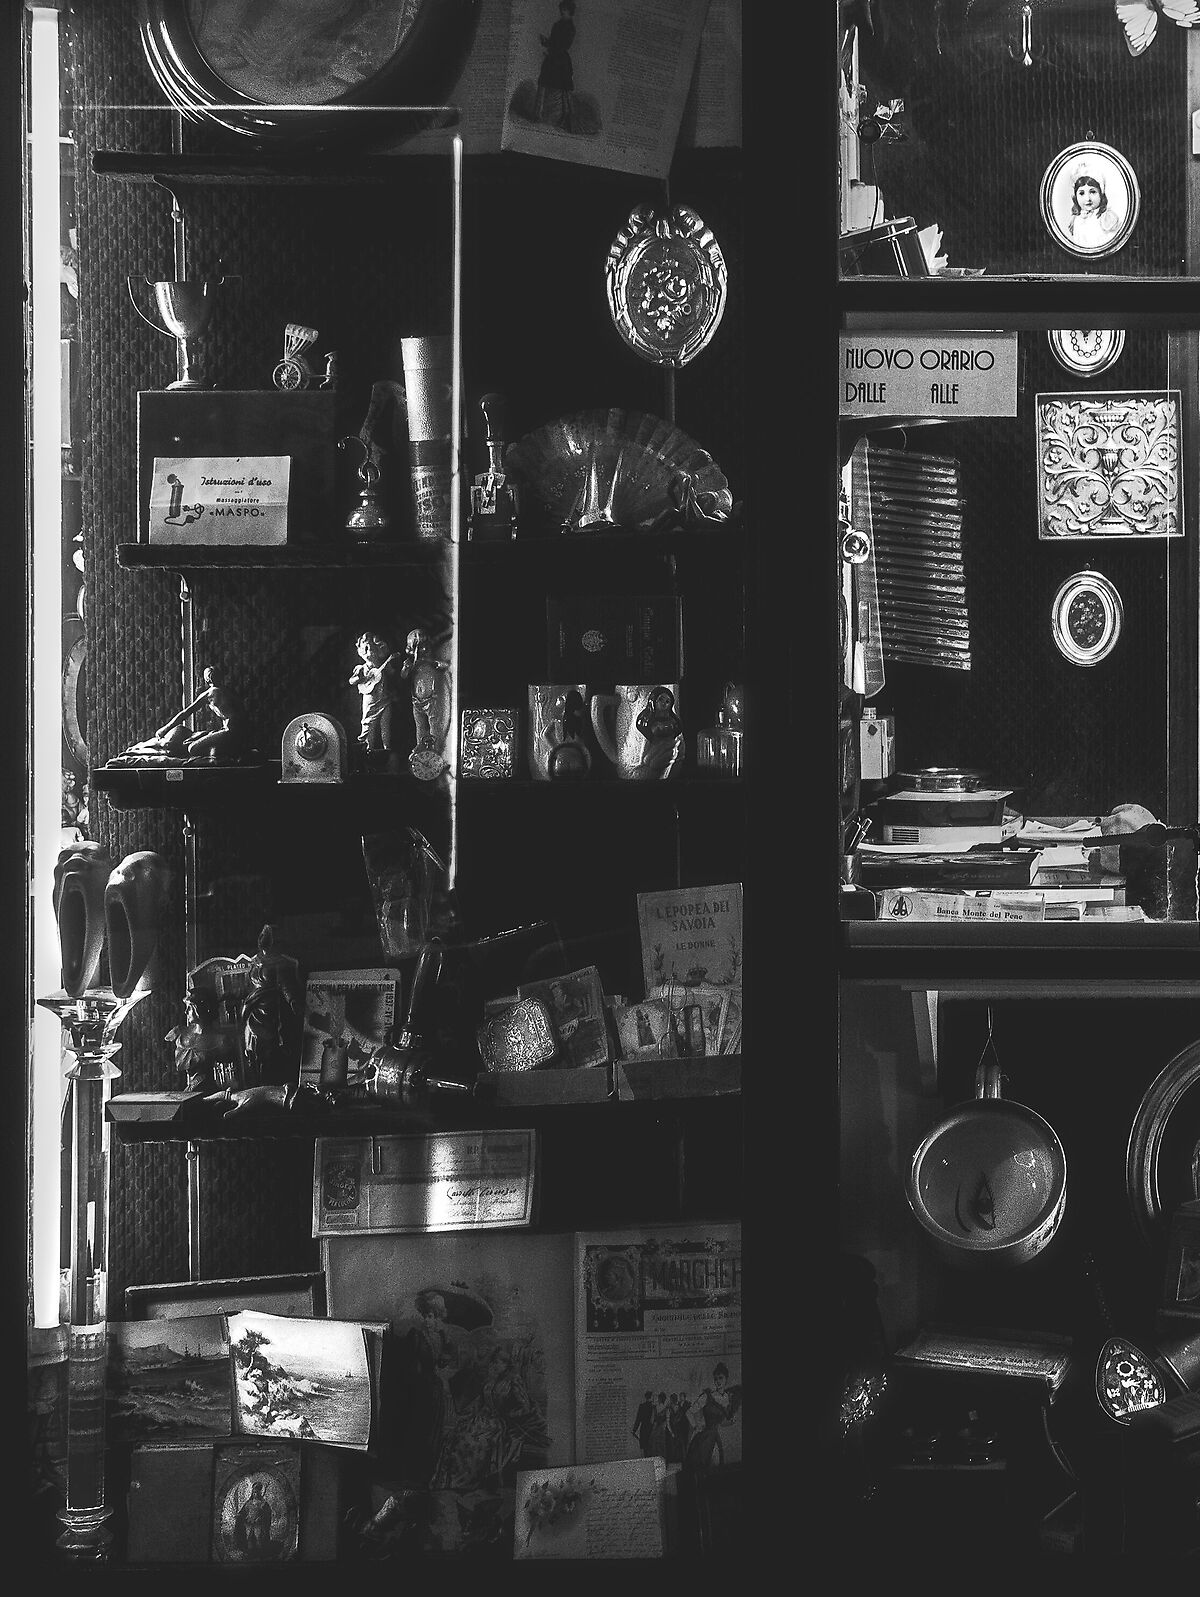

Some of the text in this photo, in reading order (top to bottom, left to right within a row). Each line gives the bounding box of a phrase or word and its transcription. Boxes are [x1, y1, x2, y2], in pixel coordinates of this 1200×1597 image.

[846, 348, 995, 371] NUOVO ORARIO
[846, 382, 959, 404] DALLE ALLE
[200, 476, 272, 486] Istruzioni d'uso
[936, 906, 959, 915] Banca
[962, 909, 987, 917] Monte
[989, 911, 1002, 919] del
[672, 917, 716, 932] SAVOIA
